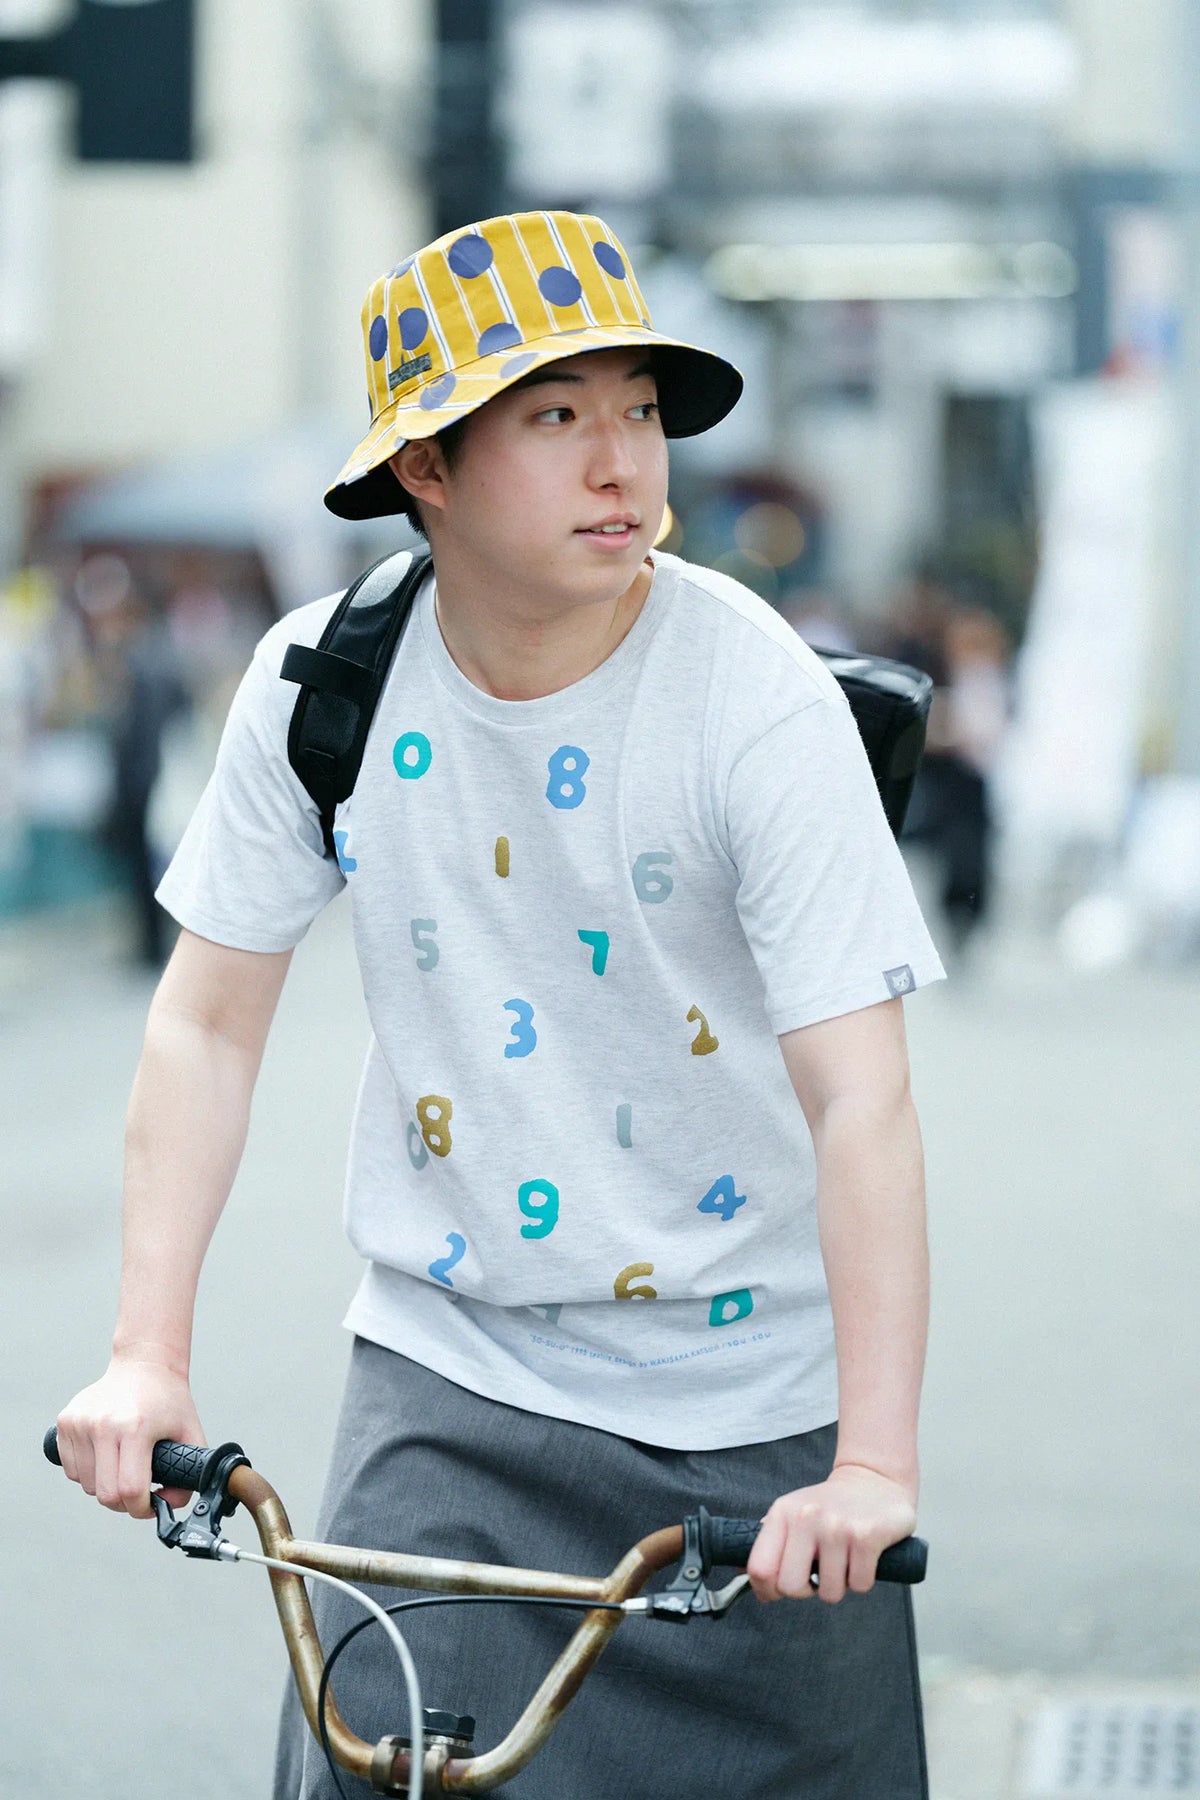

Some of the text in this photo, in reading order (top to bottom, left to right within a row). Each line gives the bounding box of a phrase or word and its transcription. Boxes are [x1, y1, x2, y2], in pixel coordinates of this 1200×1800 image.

[393, 731, 433, 780] 0
[545, 745, 590, 810] 8
[632, 851, 674, 904] 6
[410, 918, 440, 972] 5
[577, 929, 610, 977] 7
[502, 998, 538, 1059] 3
[416, 1095, 453, 1158] 8
[518, 1178, 560, 1240] 9
[696, 1174, 748, 1221] 4
[428, 1232, 467, 1288] 2
[613, 1262, 658, 1301] 6
